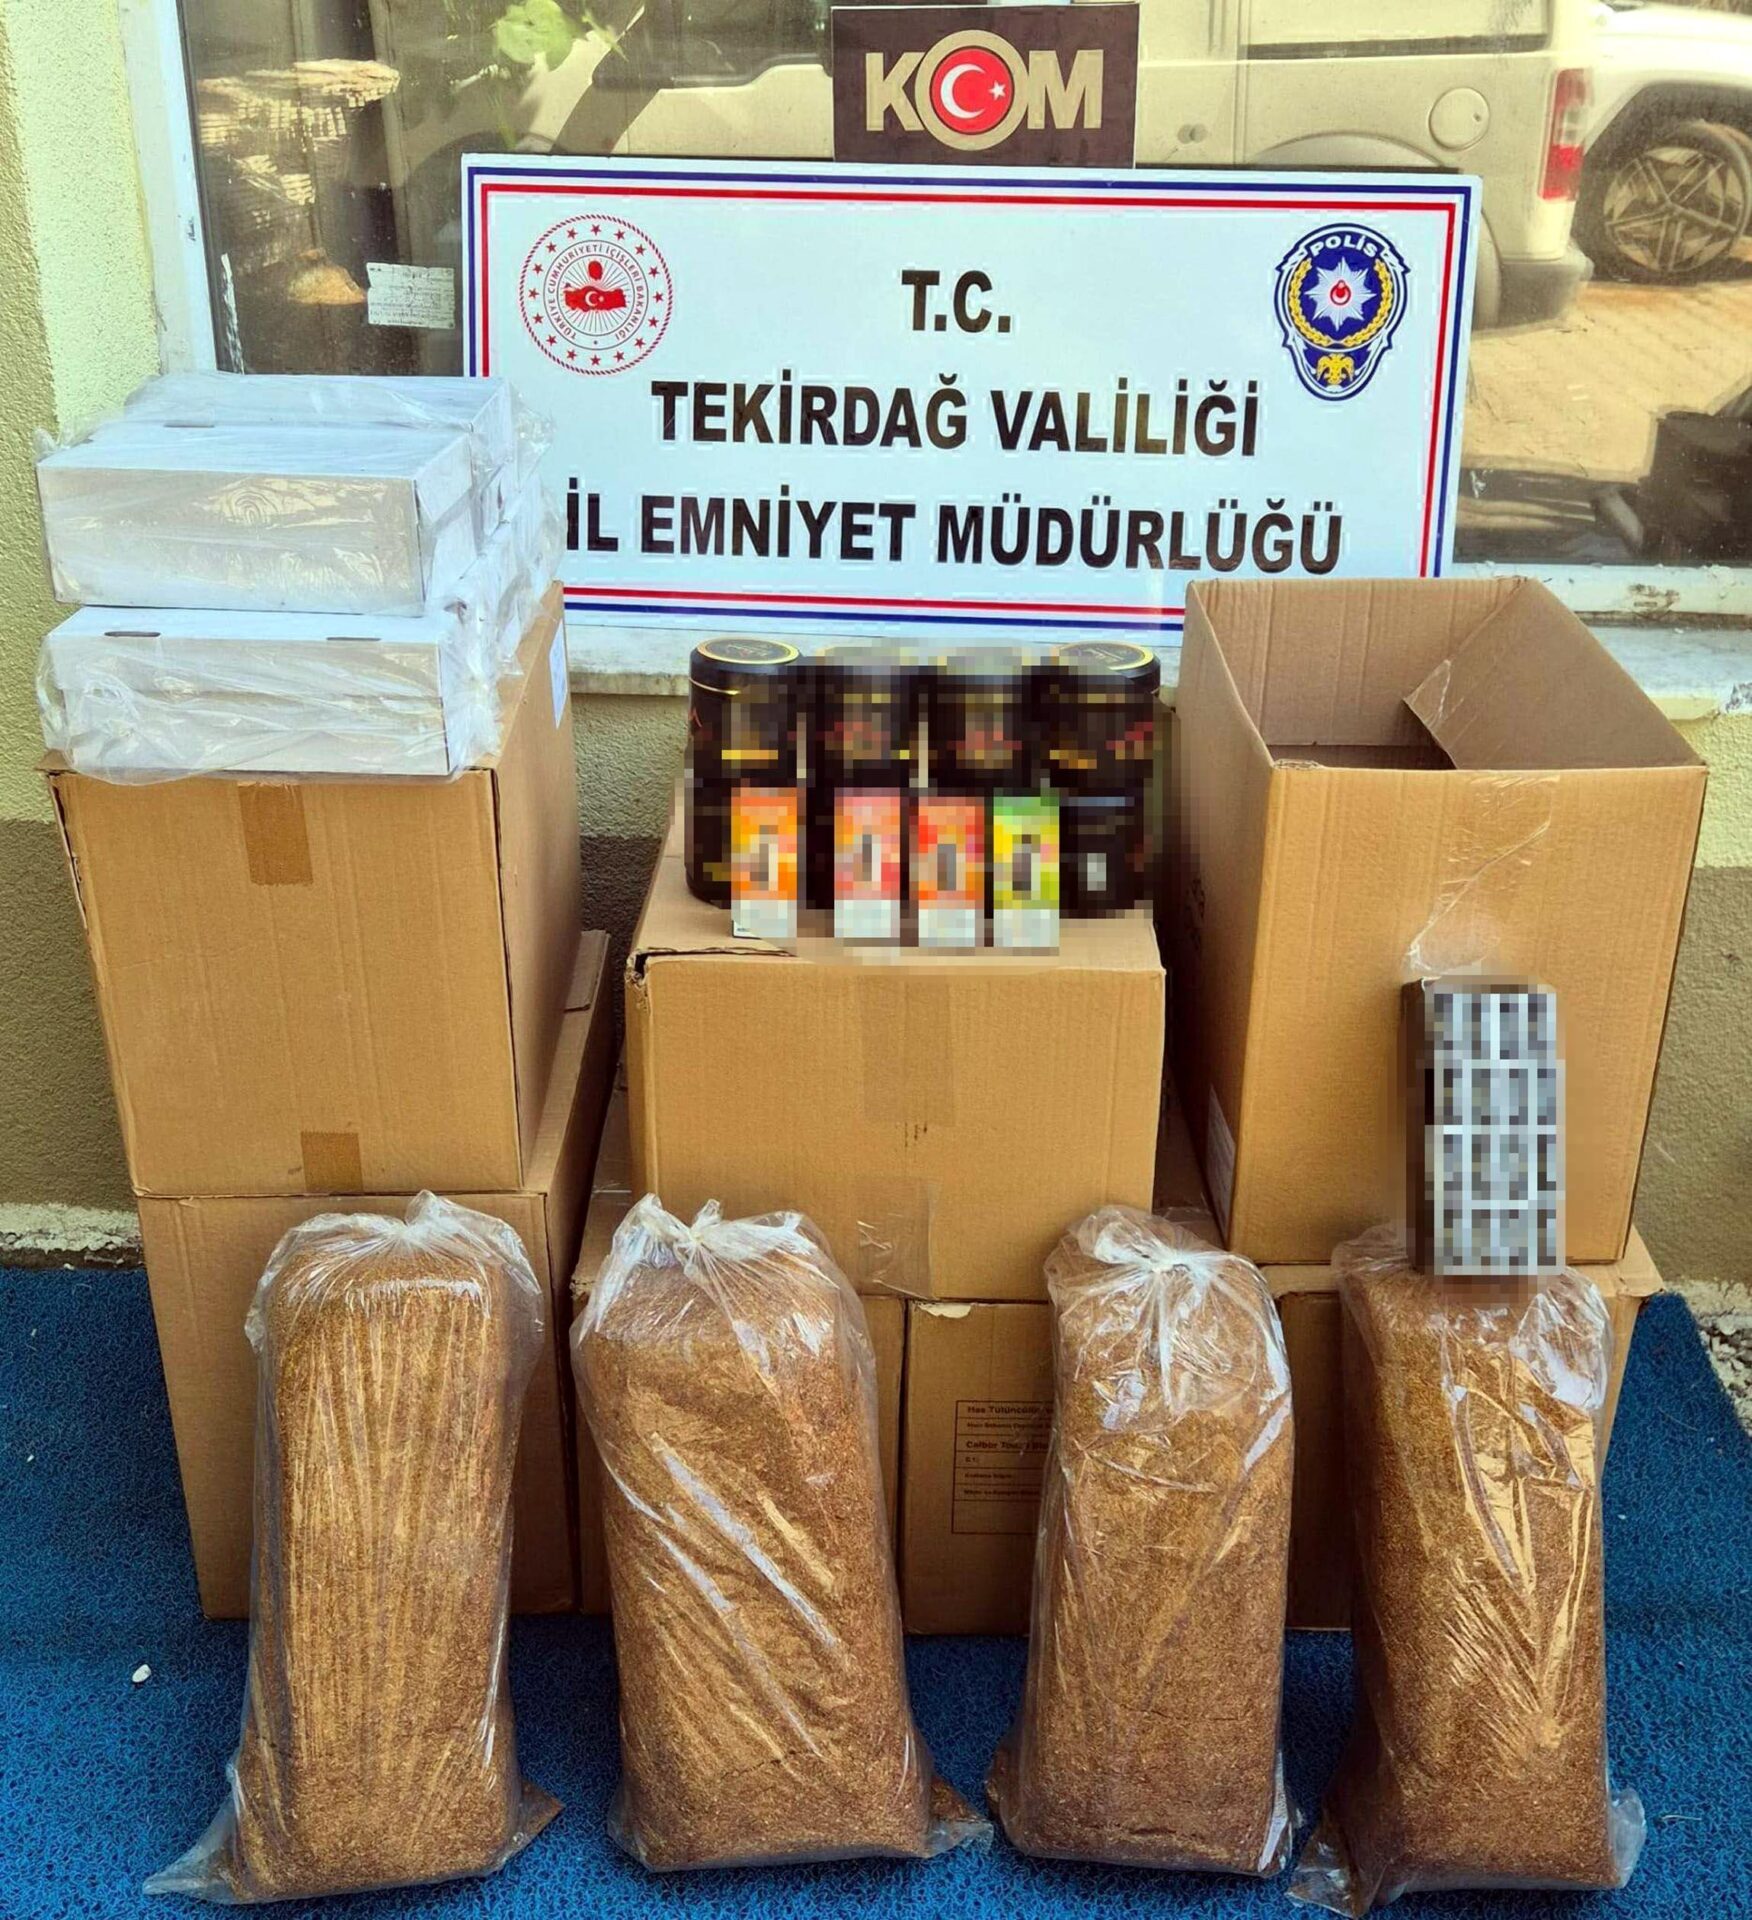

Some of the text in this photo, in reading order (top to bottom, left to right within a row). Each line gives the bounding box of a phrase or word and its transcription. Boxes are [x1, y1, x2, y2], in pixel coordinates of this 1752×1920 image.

[865, 29, 1104, 151] KOM
[1309, 234, 1378, 258] POLİS
[901, 269, 1011, 333] T.C.
[651, 369, 1258, 456] TEKİRDAĞ VALİLİĞİ
[566, 477, 1342, 575] İL EMNİYET MÜDÜRLÜĞÜ
